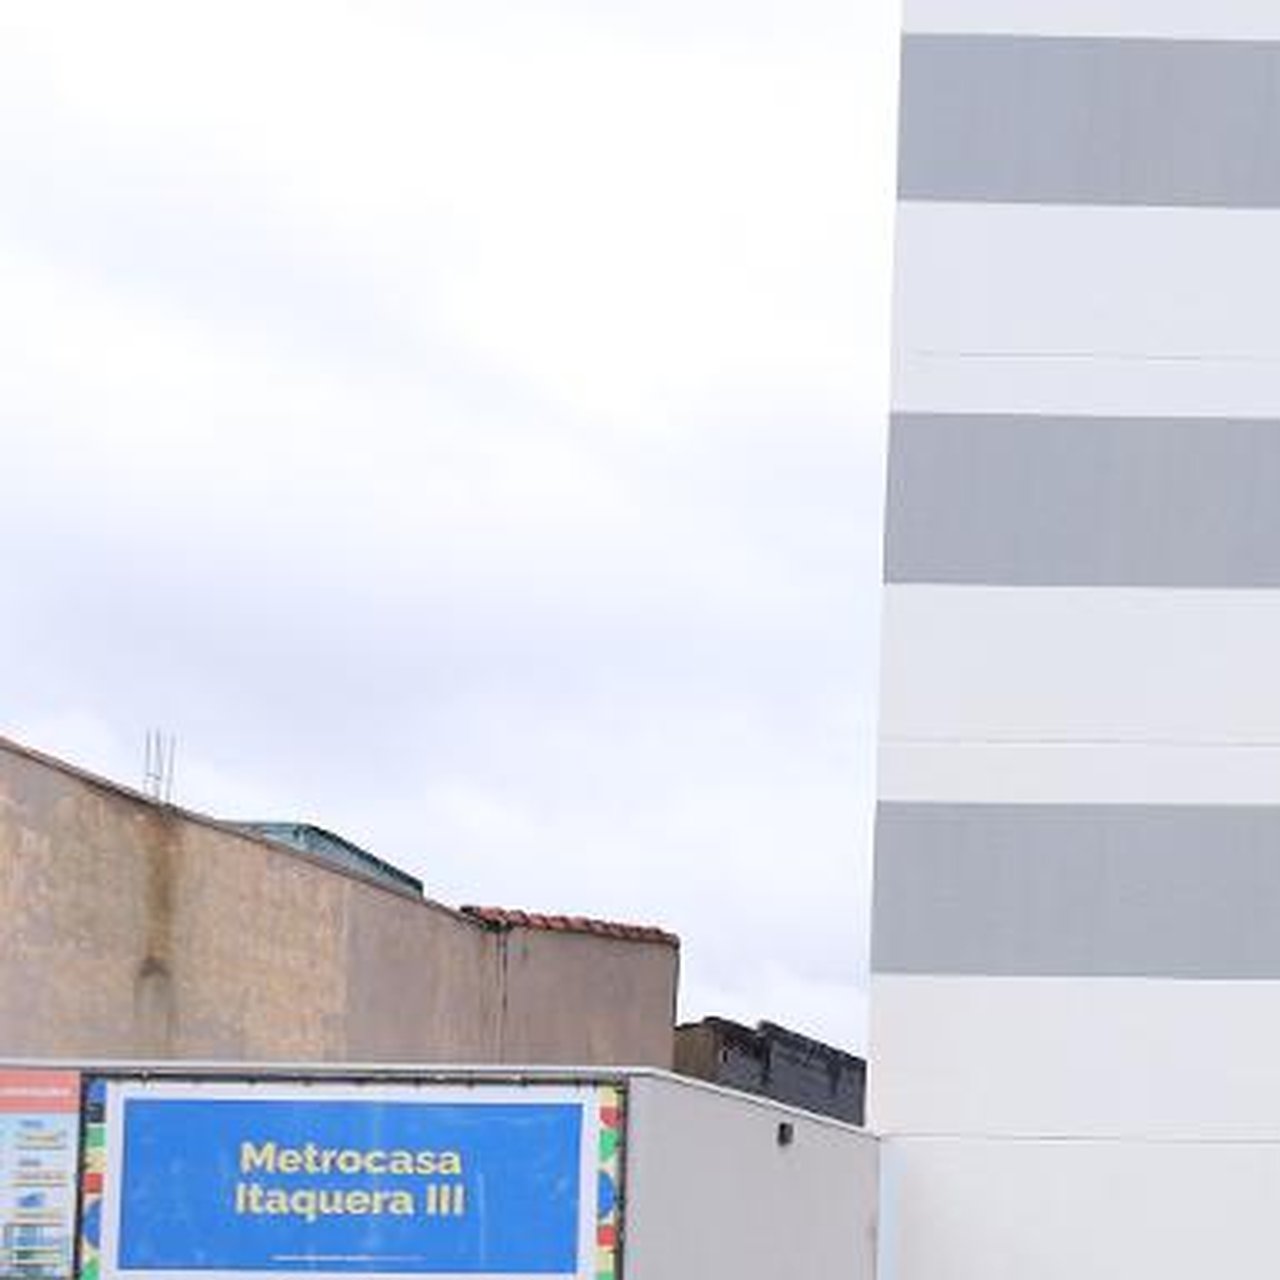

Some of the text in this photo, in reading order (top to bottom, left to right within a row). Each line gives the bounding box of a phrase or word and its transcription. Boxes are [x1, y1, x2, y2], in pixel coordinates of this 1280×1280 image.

[239, 1141, 463, 1175] Metrocasa
[235, 1183, 466, 1224] Itaquera III
